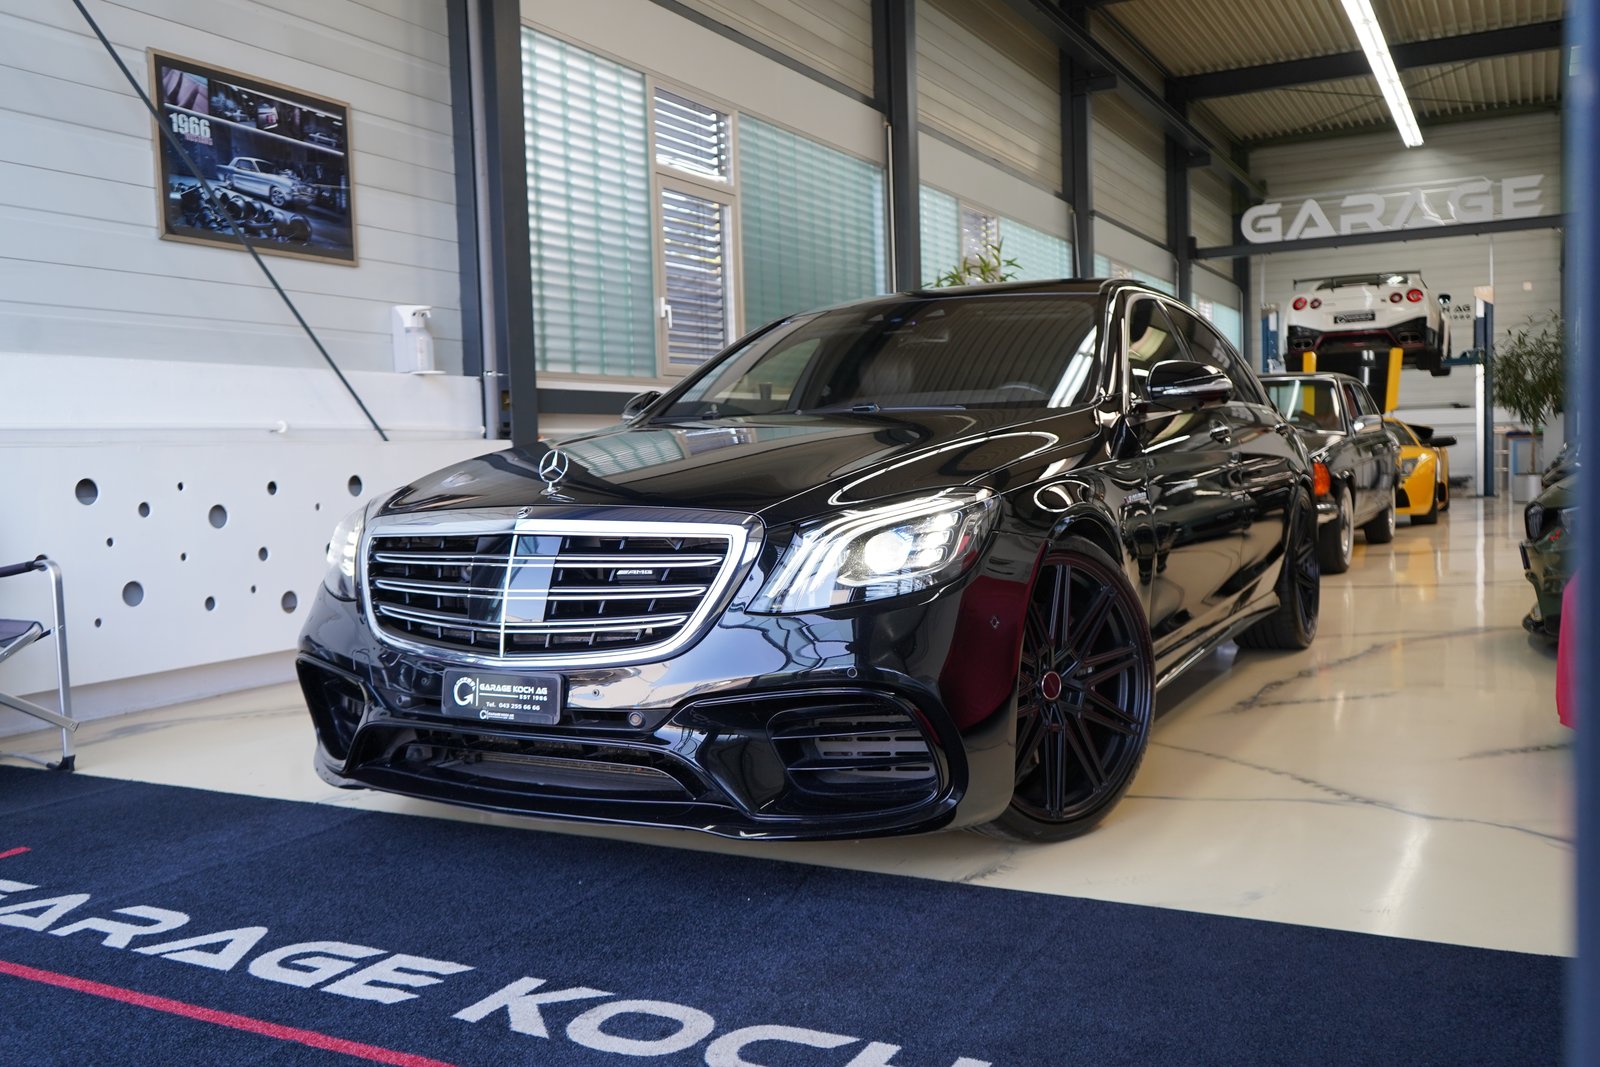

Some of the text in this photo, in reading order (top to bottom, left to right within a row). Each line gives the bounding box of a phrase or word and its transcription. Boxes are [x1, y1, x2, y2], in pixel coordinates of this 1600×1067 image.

[169, 112, 211, 138] 1966
[1241, 174, 1544, 244] GARAGE
[480, 683, 548, 695] GARAGE KOCH AG
